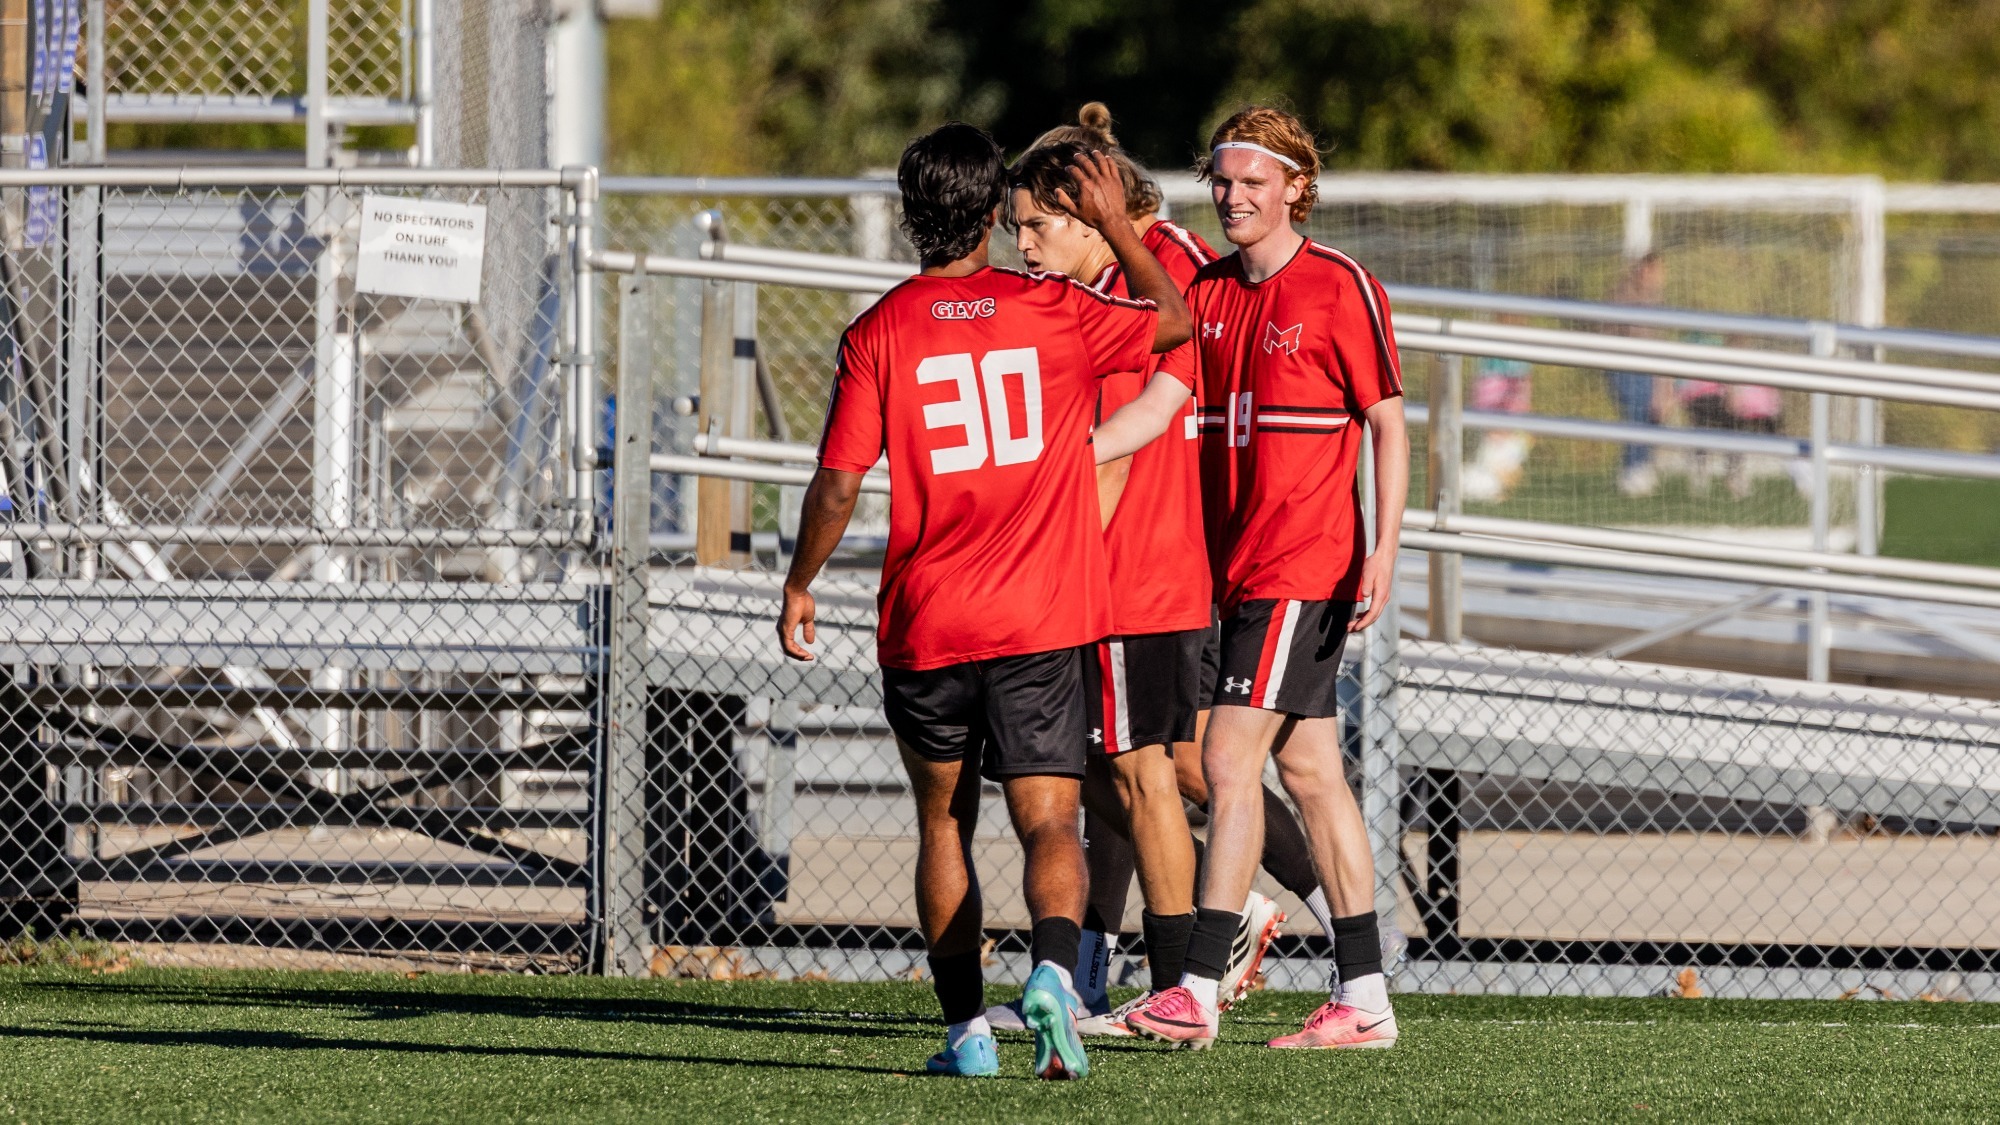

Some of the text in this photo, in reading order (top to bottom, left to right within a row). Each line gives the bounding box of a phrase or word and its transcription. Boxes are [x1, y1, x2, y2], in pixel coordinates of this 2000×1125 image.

[374, 211, 474, 230] NO SPECTATORS
[395, 232, 448, 247] ON TURF
[384, 251, 458, 268] THANK YOU!
[931, 297, 996, 320] GLVC
[915, 346, 1045, 475] 30
[1227, 391, 1253, 448] 19
